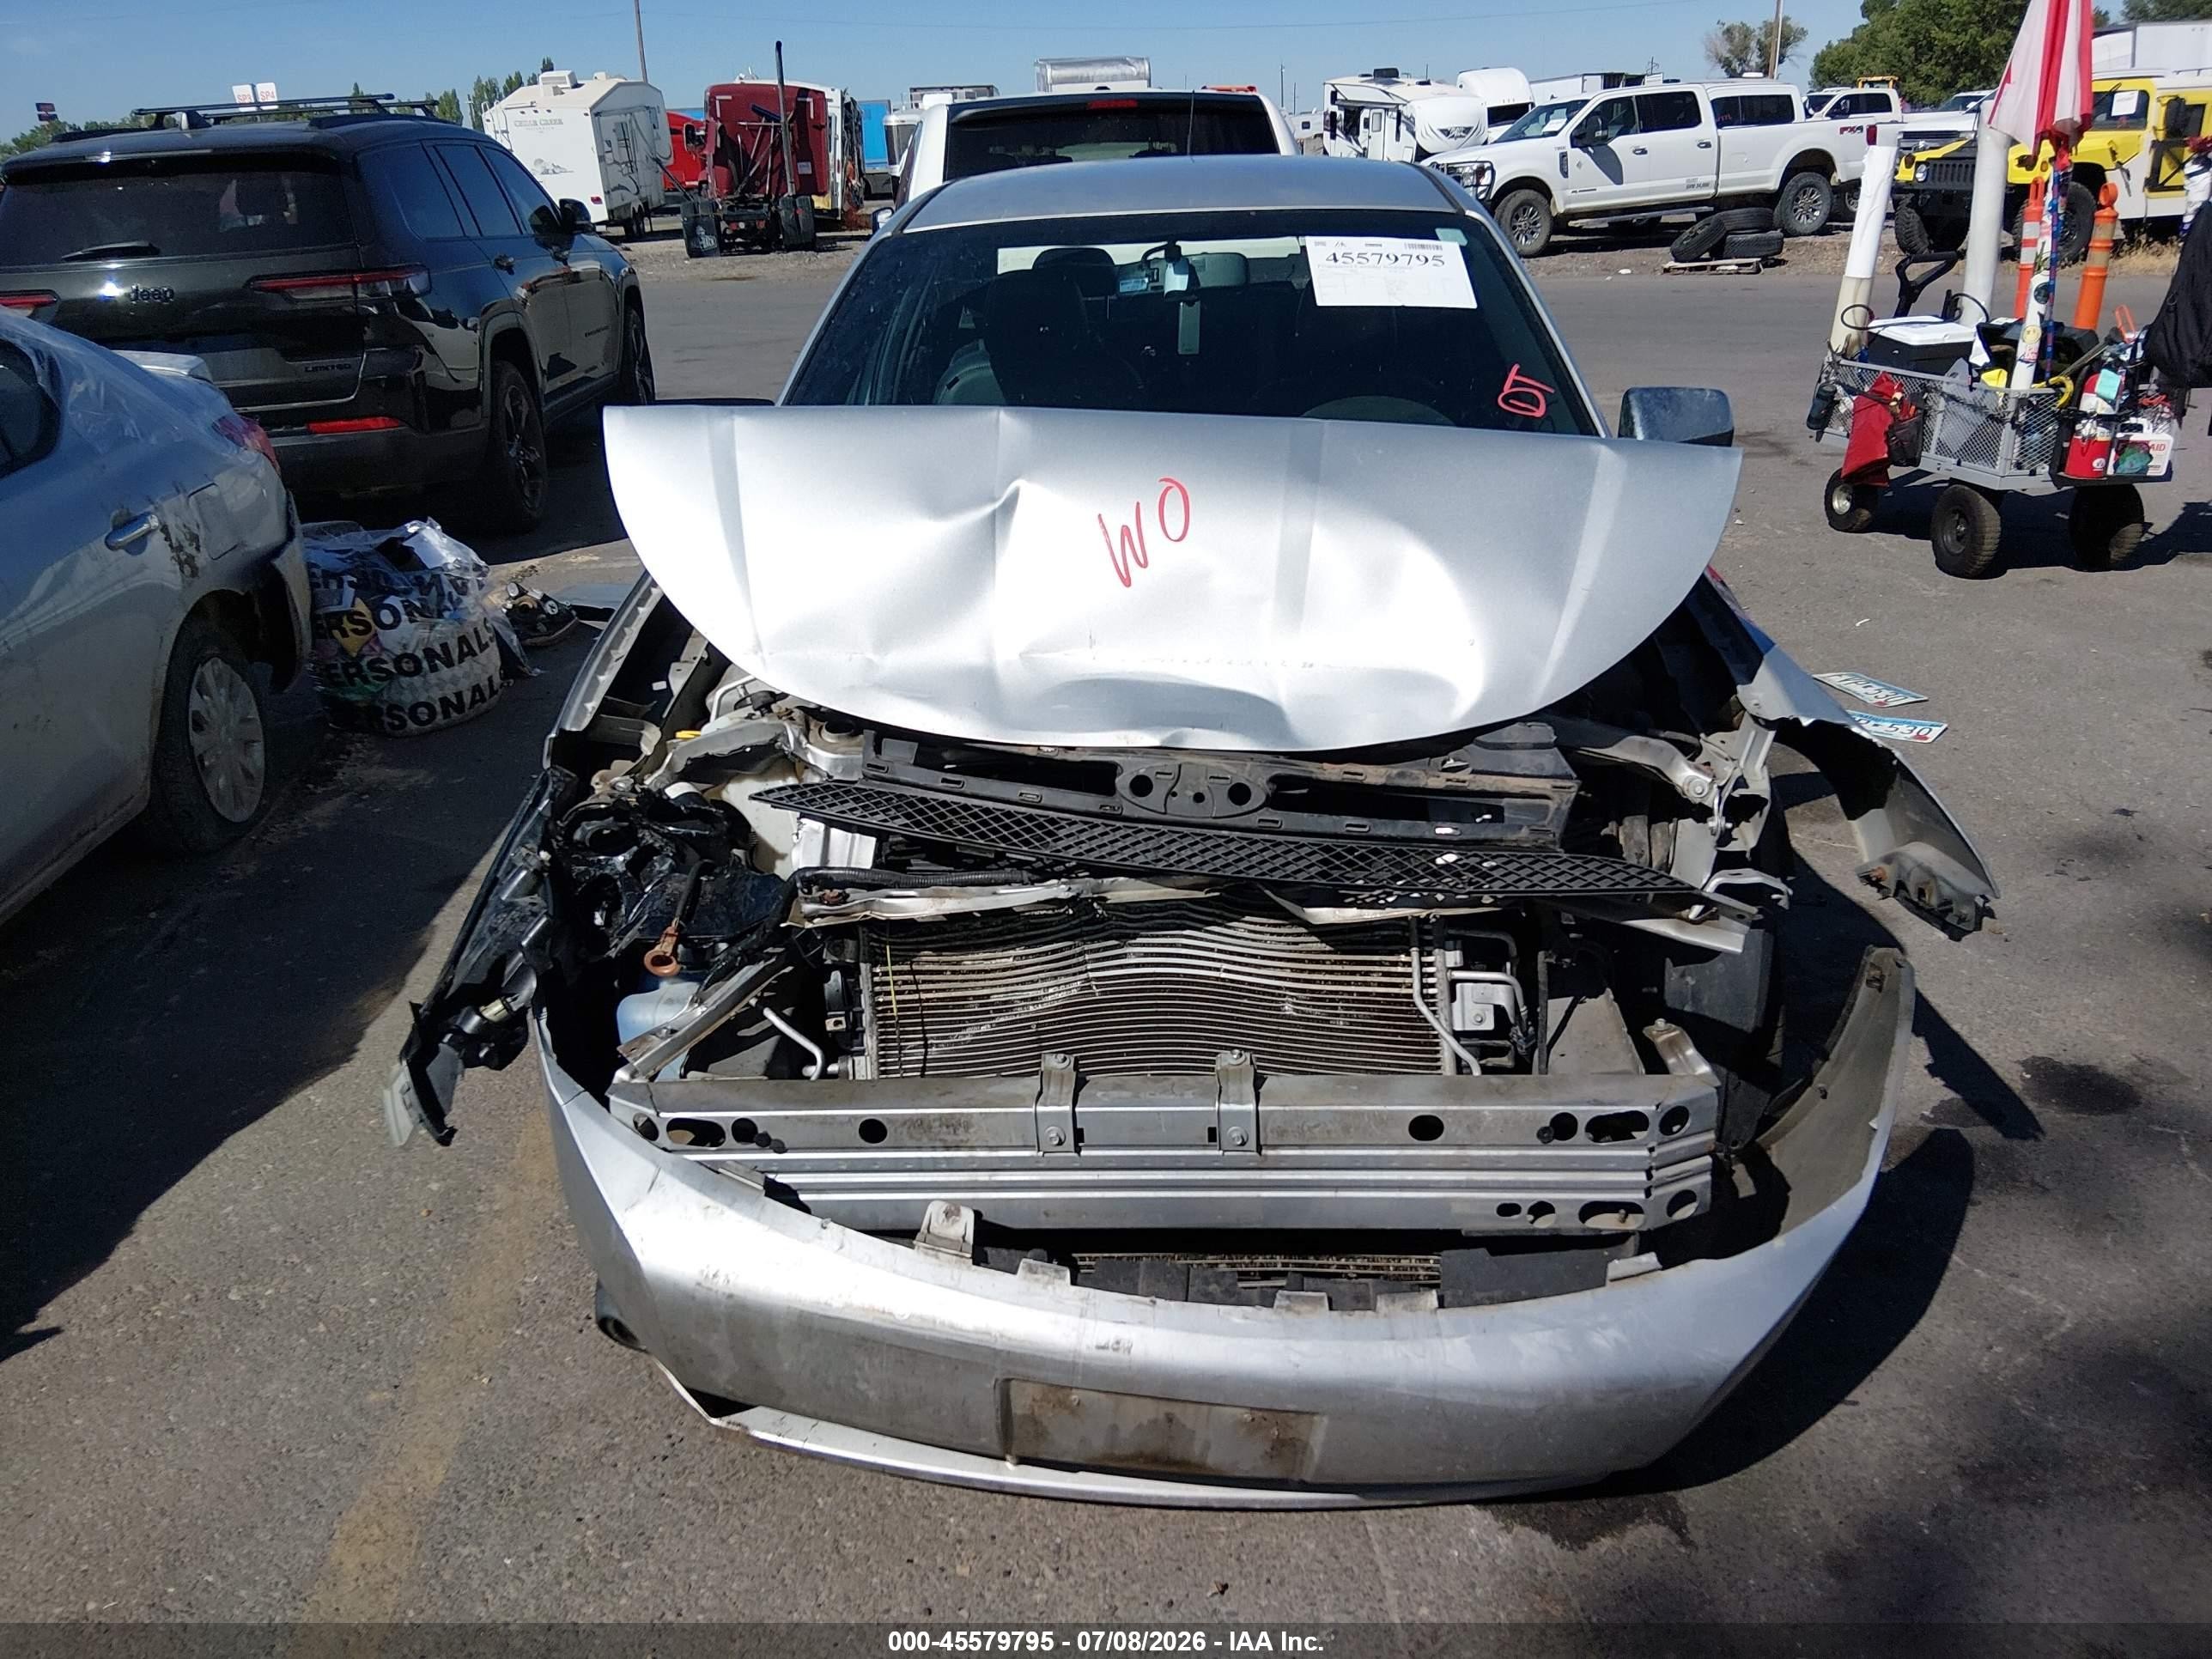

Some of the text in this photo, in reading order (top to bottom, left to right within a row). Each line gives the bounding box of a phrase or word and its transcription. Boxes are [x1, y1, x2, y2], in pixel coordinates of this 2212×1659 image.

[259, 90, 276, 101] SP4
[1839, 126, 1864, 135] FX4
[1325, 252, 1445, 268] 45579795
[305, 363, 351, 374] LIMITED
[2149, 443, 2166, 452] AID
